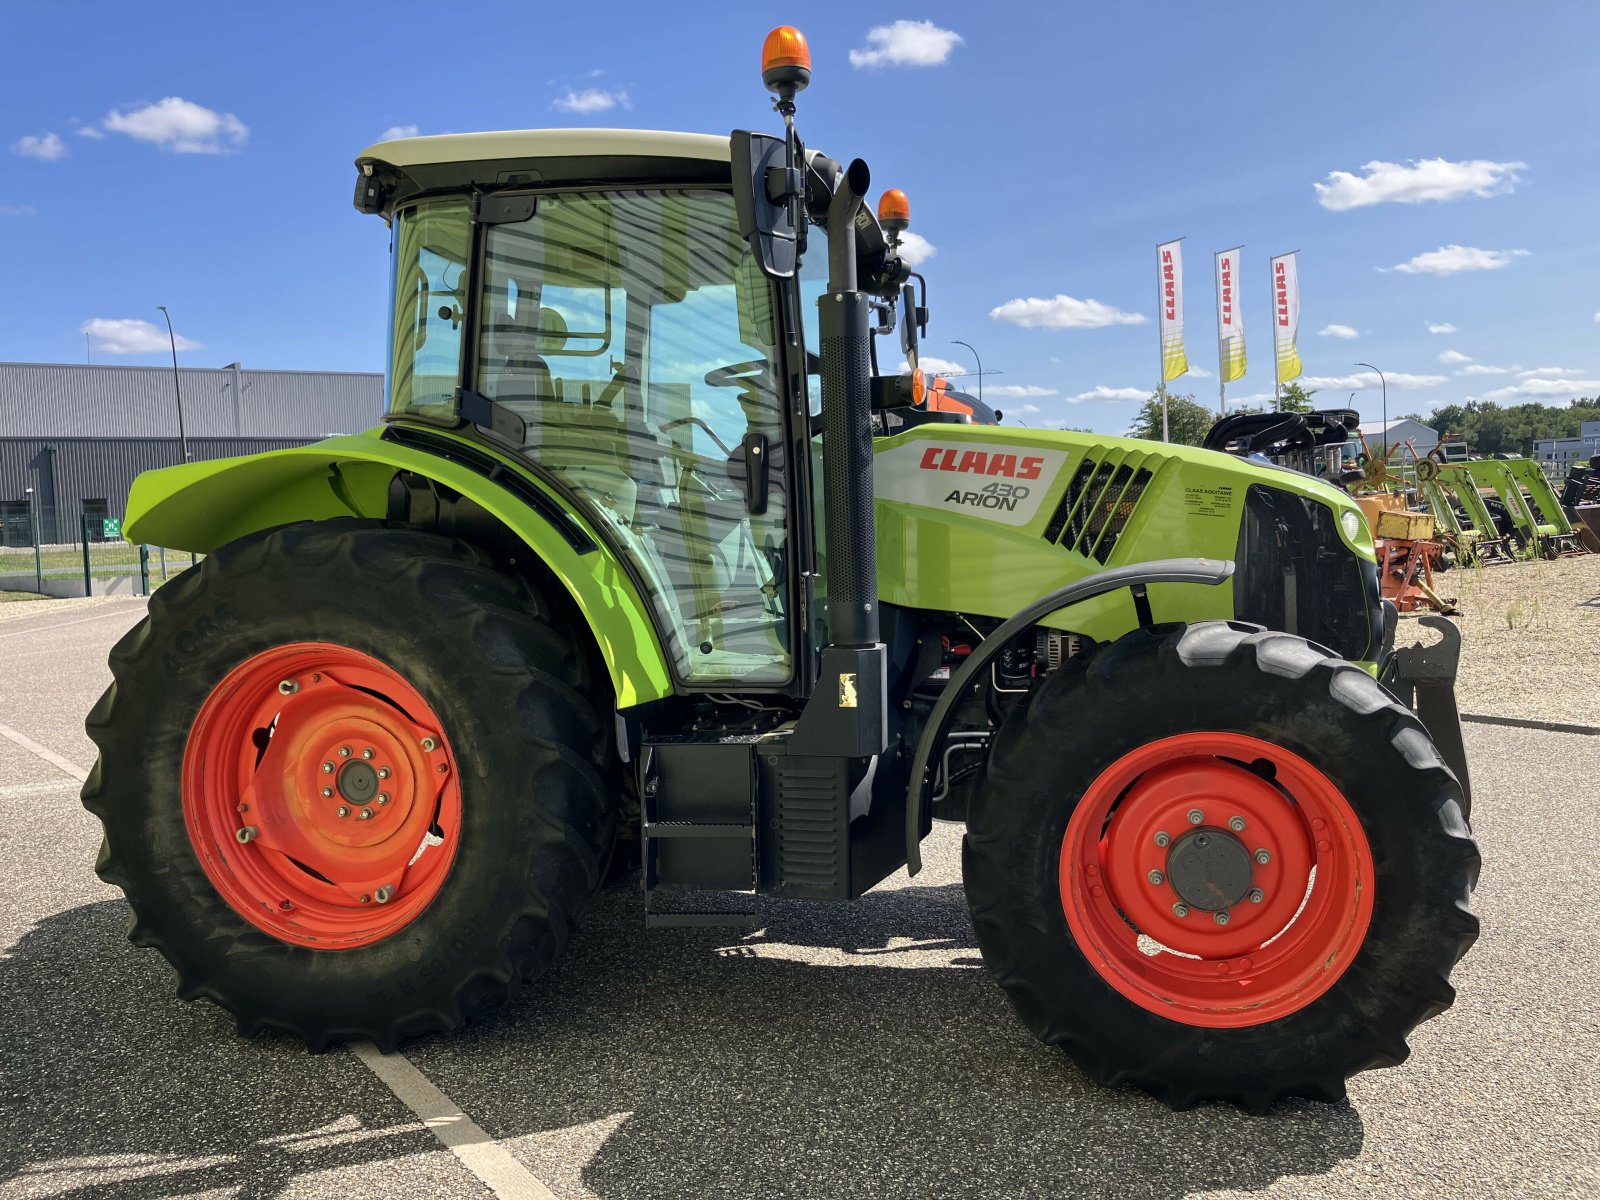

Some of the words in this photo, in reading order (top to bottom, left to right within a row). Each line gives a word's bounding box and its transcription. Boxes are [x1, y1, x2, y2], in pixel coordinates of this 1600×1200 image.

[1162, 250, 1175, 320] CLAAS
[1221, 257, 1231, 325] CLAAS
[1275, 262, 1289, 326] CLAAS
[919, 447, 1044, 480] CLAAS
[944, 489, 1018, 511] ARION
[981, 482, 1030, 499] 430
